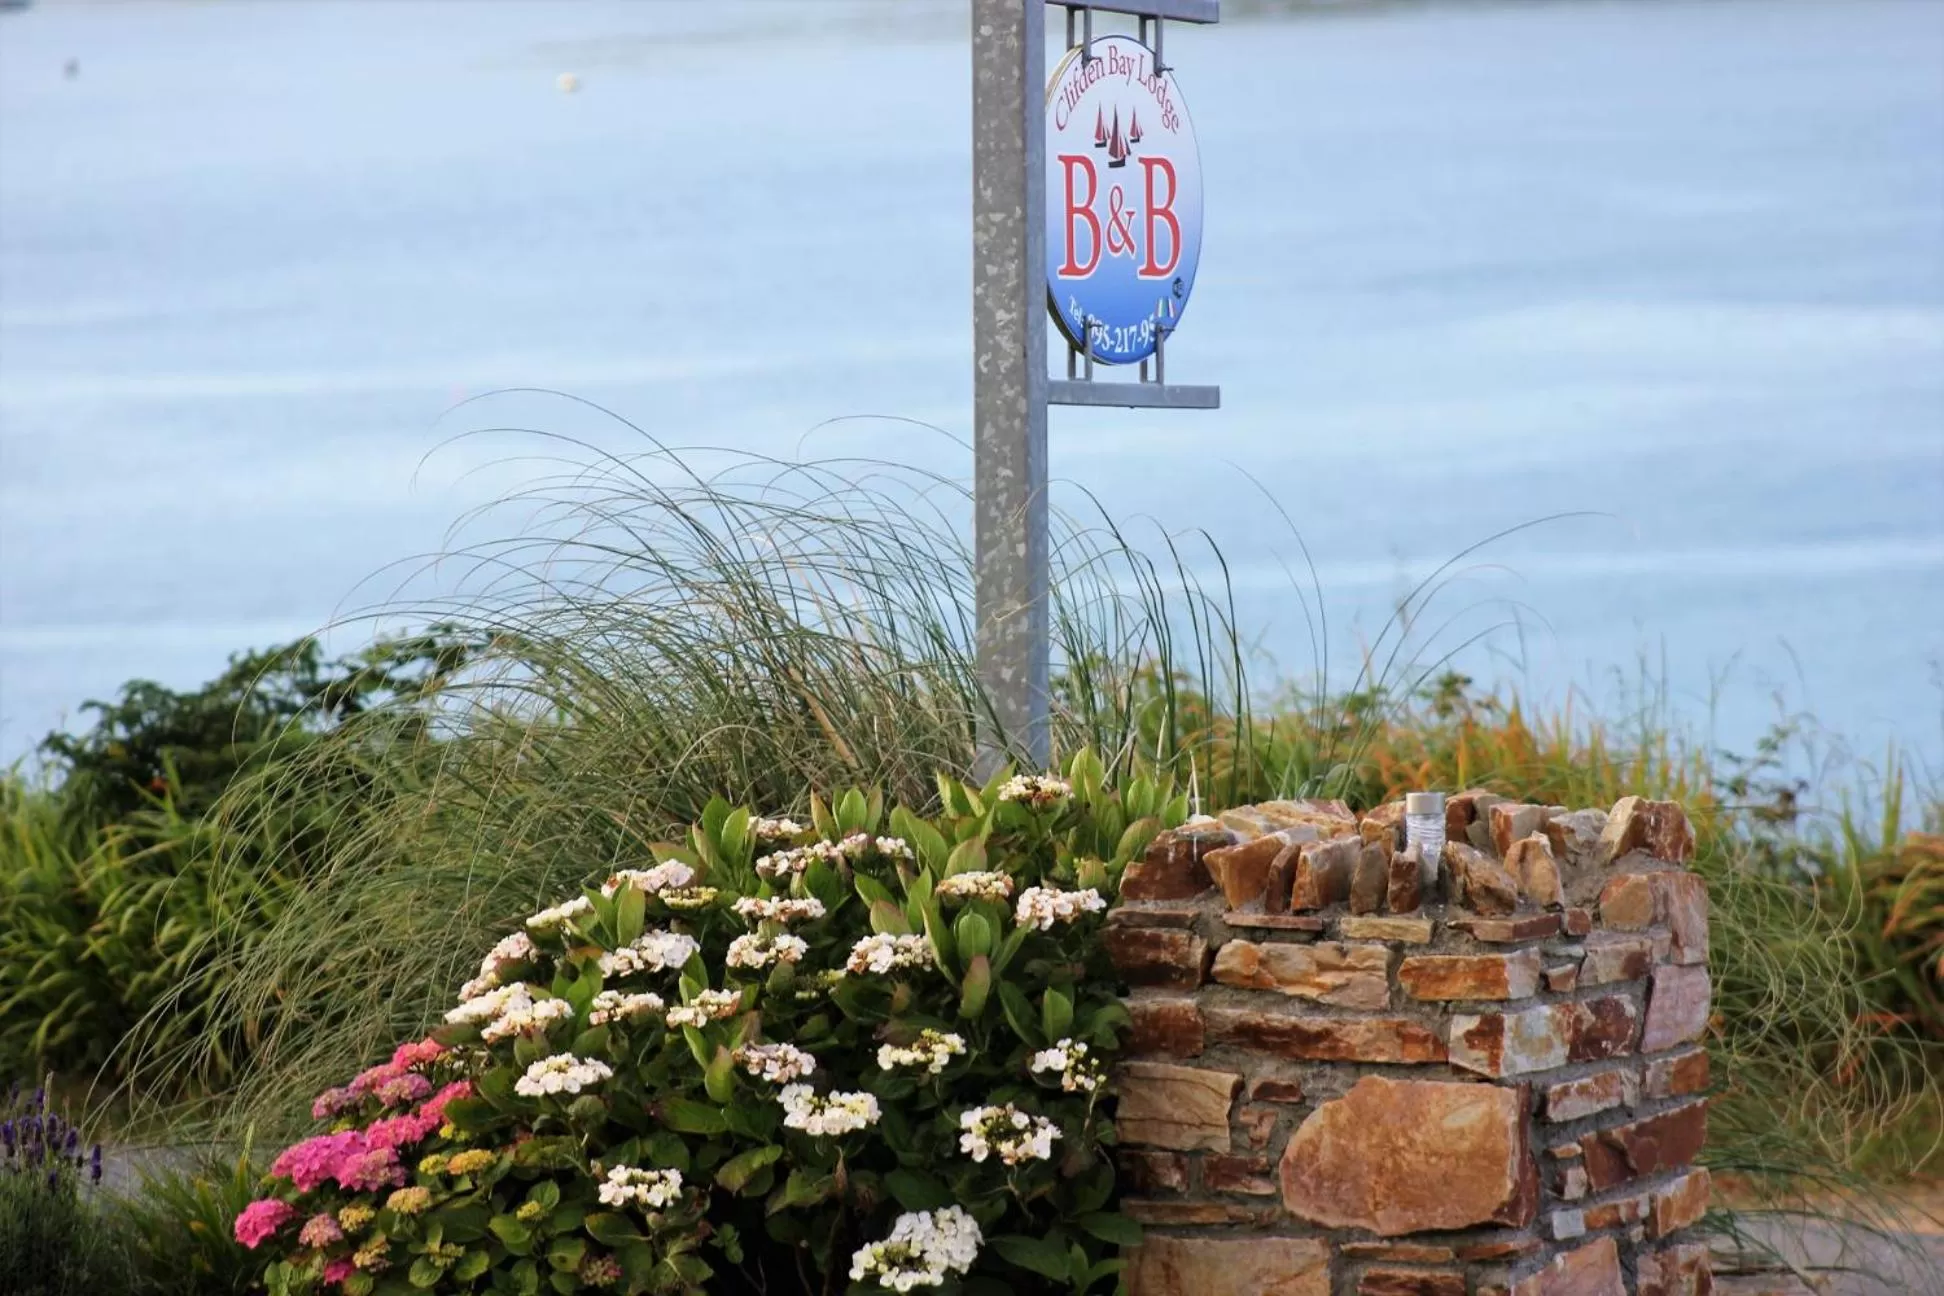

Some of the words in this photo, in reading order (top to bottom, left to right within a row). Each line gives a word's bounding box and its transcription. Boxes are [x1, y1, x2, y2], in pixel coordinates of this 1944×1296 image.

[1108, 45, 1135, 86] Bay
[1137, 53, 1179, 135] Lodge
[1057, 155, 1182, 280] B&B
